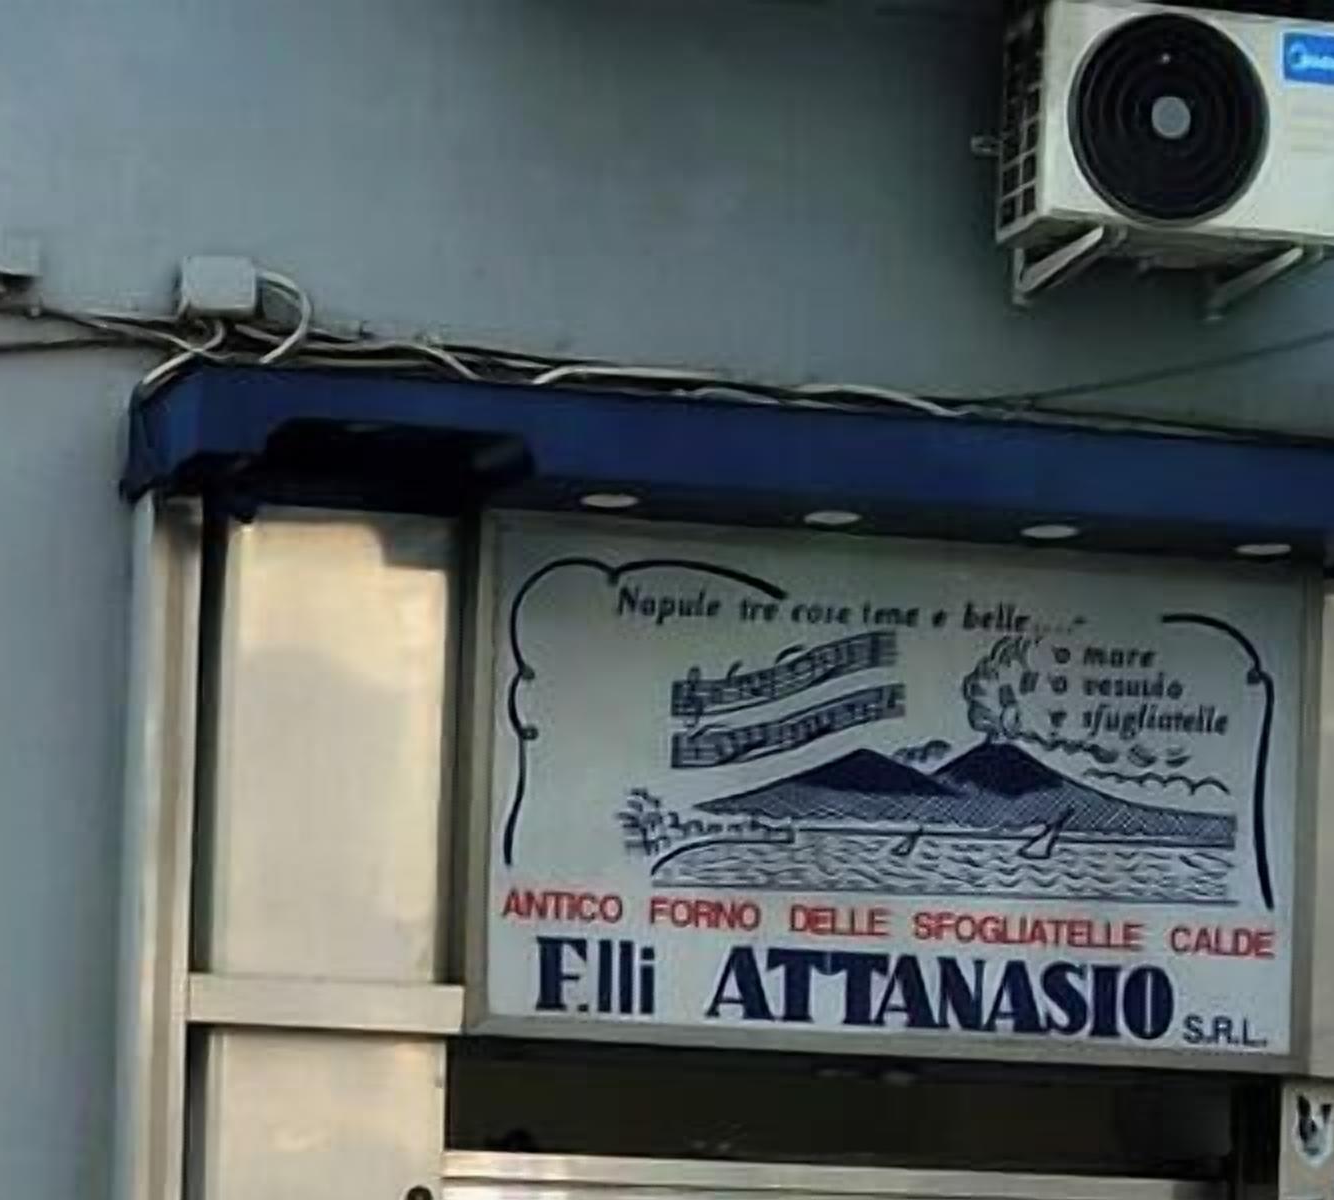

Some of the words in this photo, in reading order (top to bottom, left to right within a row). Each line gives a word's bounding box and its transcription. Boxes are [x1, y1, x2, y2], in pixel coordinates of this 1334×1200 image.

[740, 598, 779, 622] tre
[791, 602, 850, 625] cose
[1083, 646, 1156, 668] mare
[502, 887, 624, 925] ANTICO
[650, 896, 762, 932] FORNO
[789, 904, 891, 938] DELLE
[911, 911, 1145, 952] SFOGLIATELLE
[1170, 924, 1276, 960] CALDE
[535, 935, 655, 1015] F.lli
[705, 944, 1175, 1042] ATTANASIO
